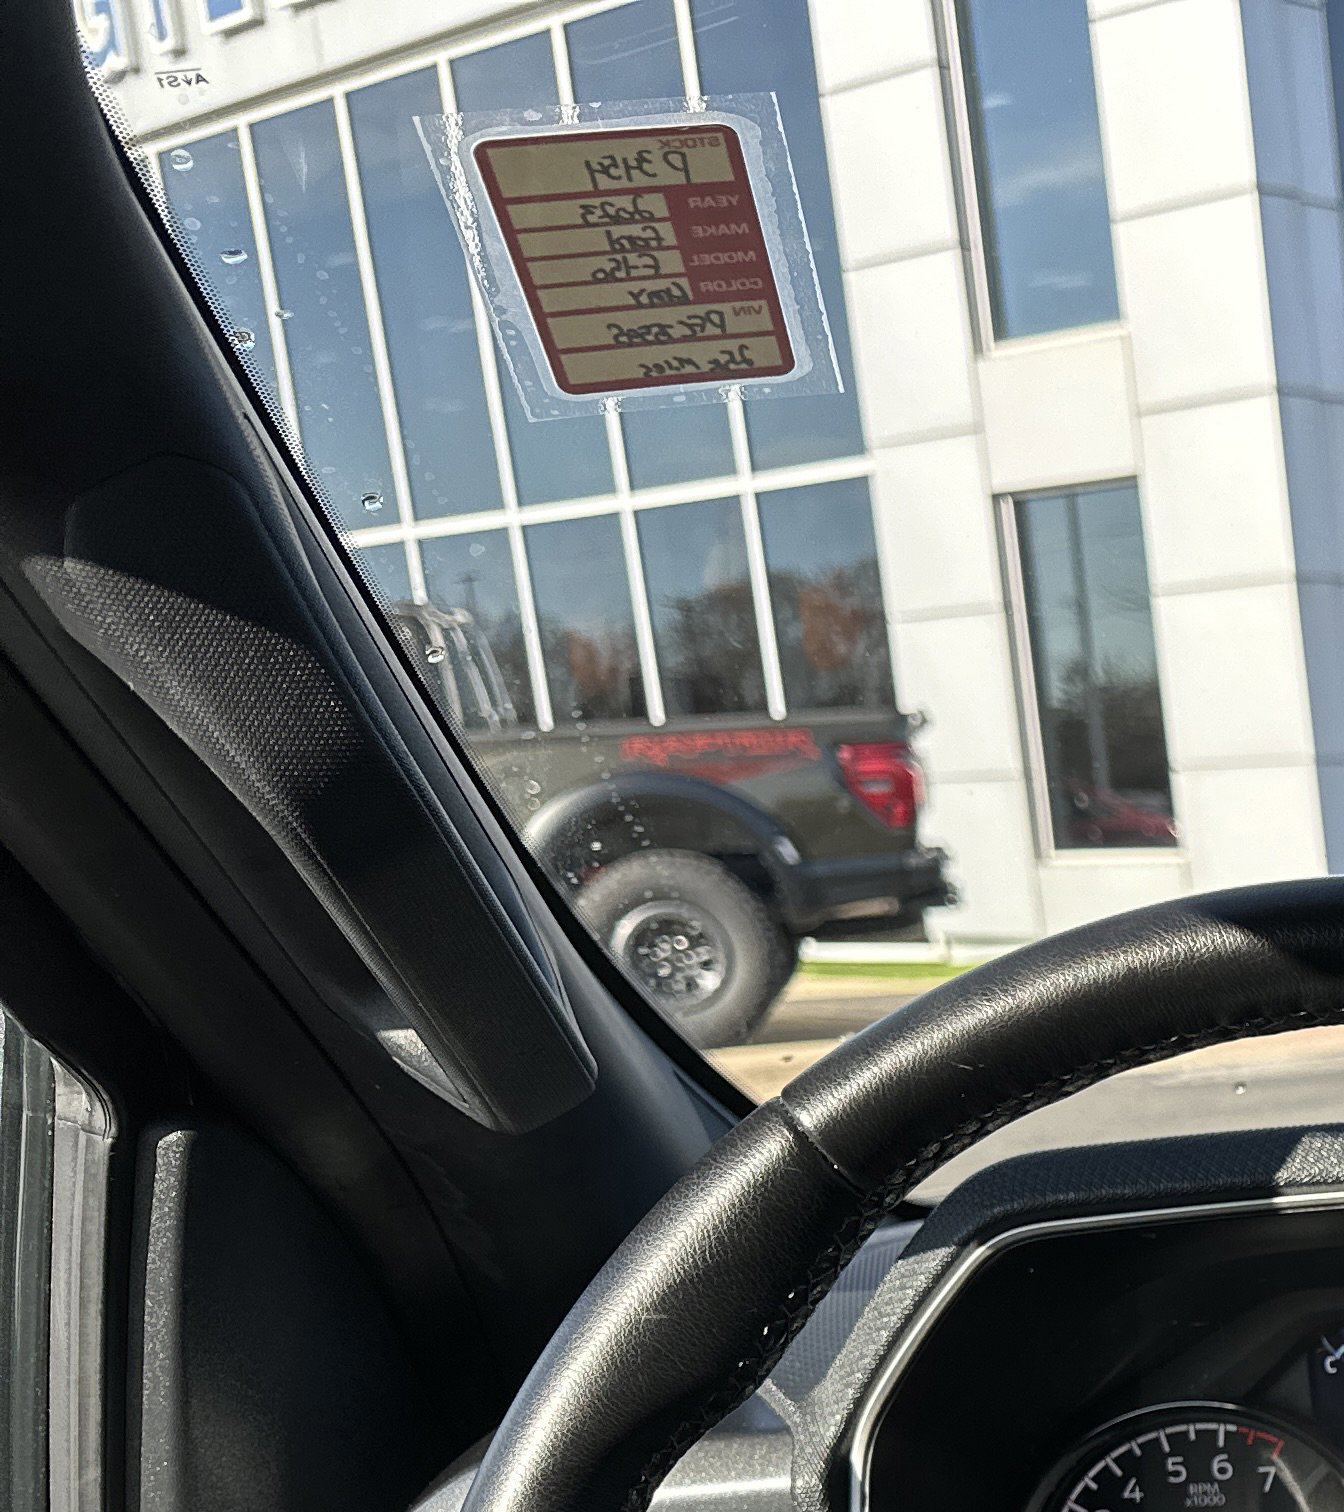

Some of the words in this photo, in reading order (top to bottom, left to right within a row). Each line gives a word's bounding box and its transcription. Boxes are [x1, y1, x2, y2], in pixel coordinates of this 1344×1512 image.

[1323, 1356, 1338, 1375] C
[1166, 1457, 1187, 1484] 5
[1211, 1456, 1234, 1481] 6
[1257, 1465, 1277, 1492] 7
[1122, 1478, 1144, 1503] 4
[1188, 1482, 1220, 1496] RPM
